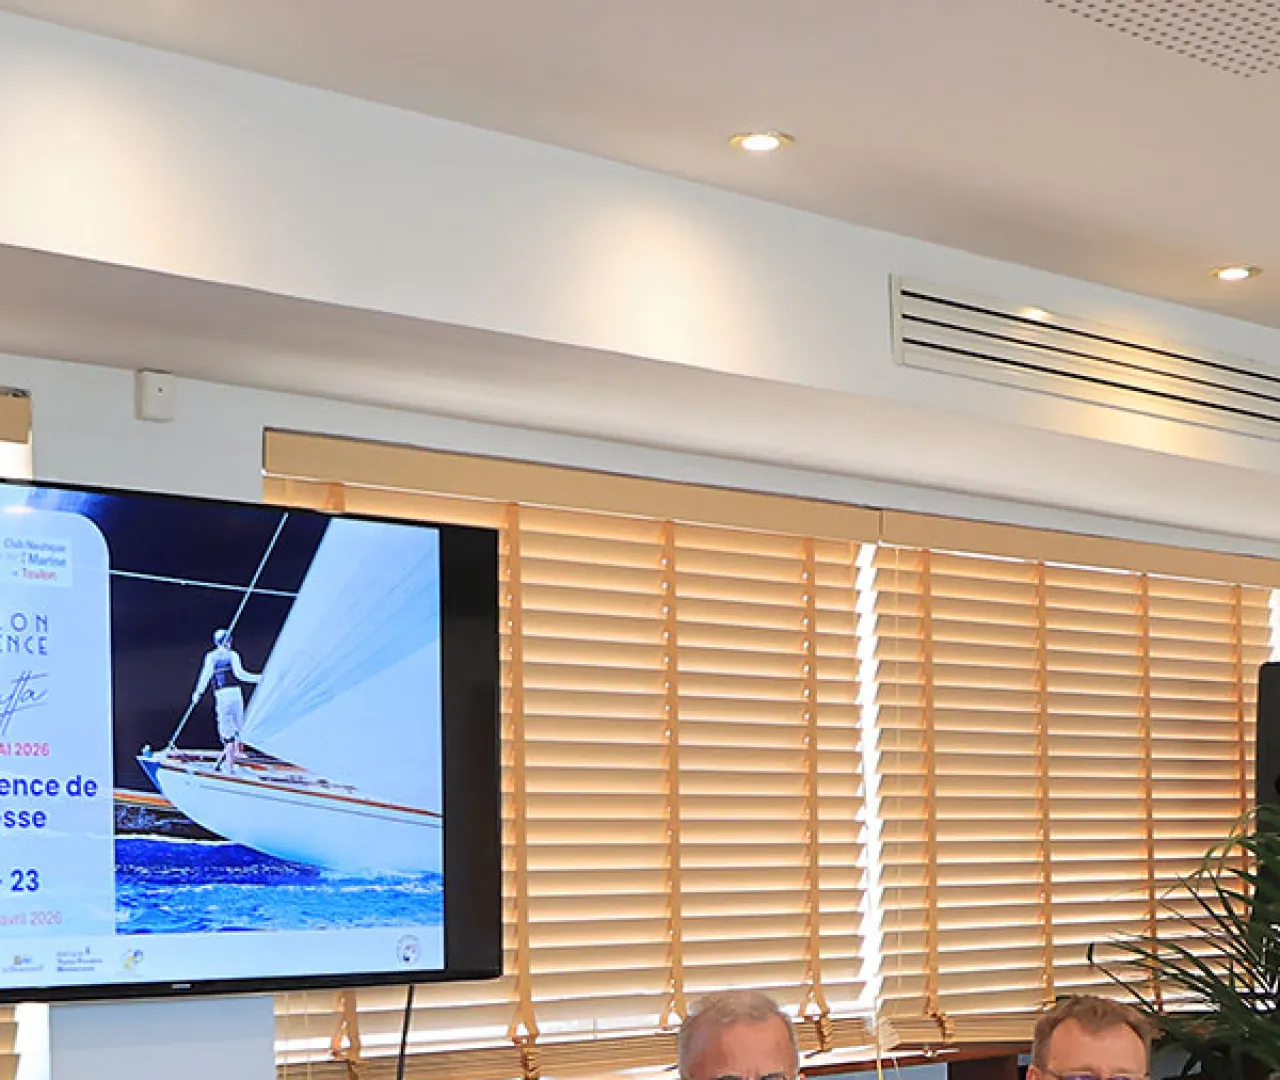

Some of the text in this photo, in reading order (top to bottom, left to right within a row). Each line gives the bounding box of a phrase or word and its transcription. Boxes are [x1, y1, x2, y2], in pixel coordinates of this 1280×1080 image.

[14, 742, 50, 757] 2026
[66, 775, 99, 797] de
[10, 868, 40, 893] 23
[30, 911, 63, 926] 2026
